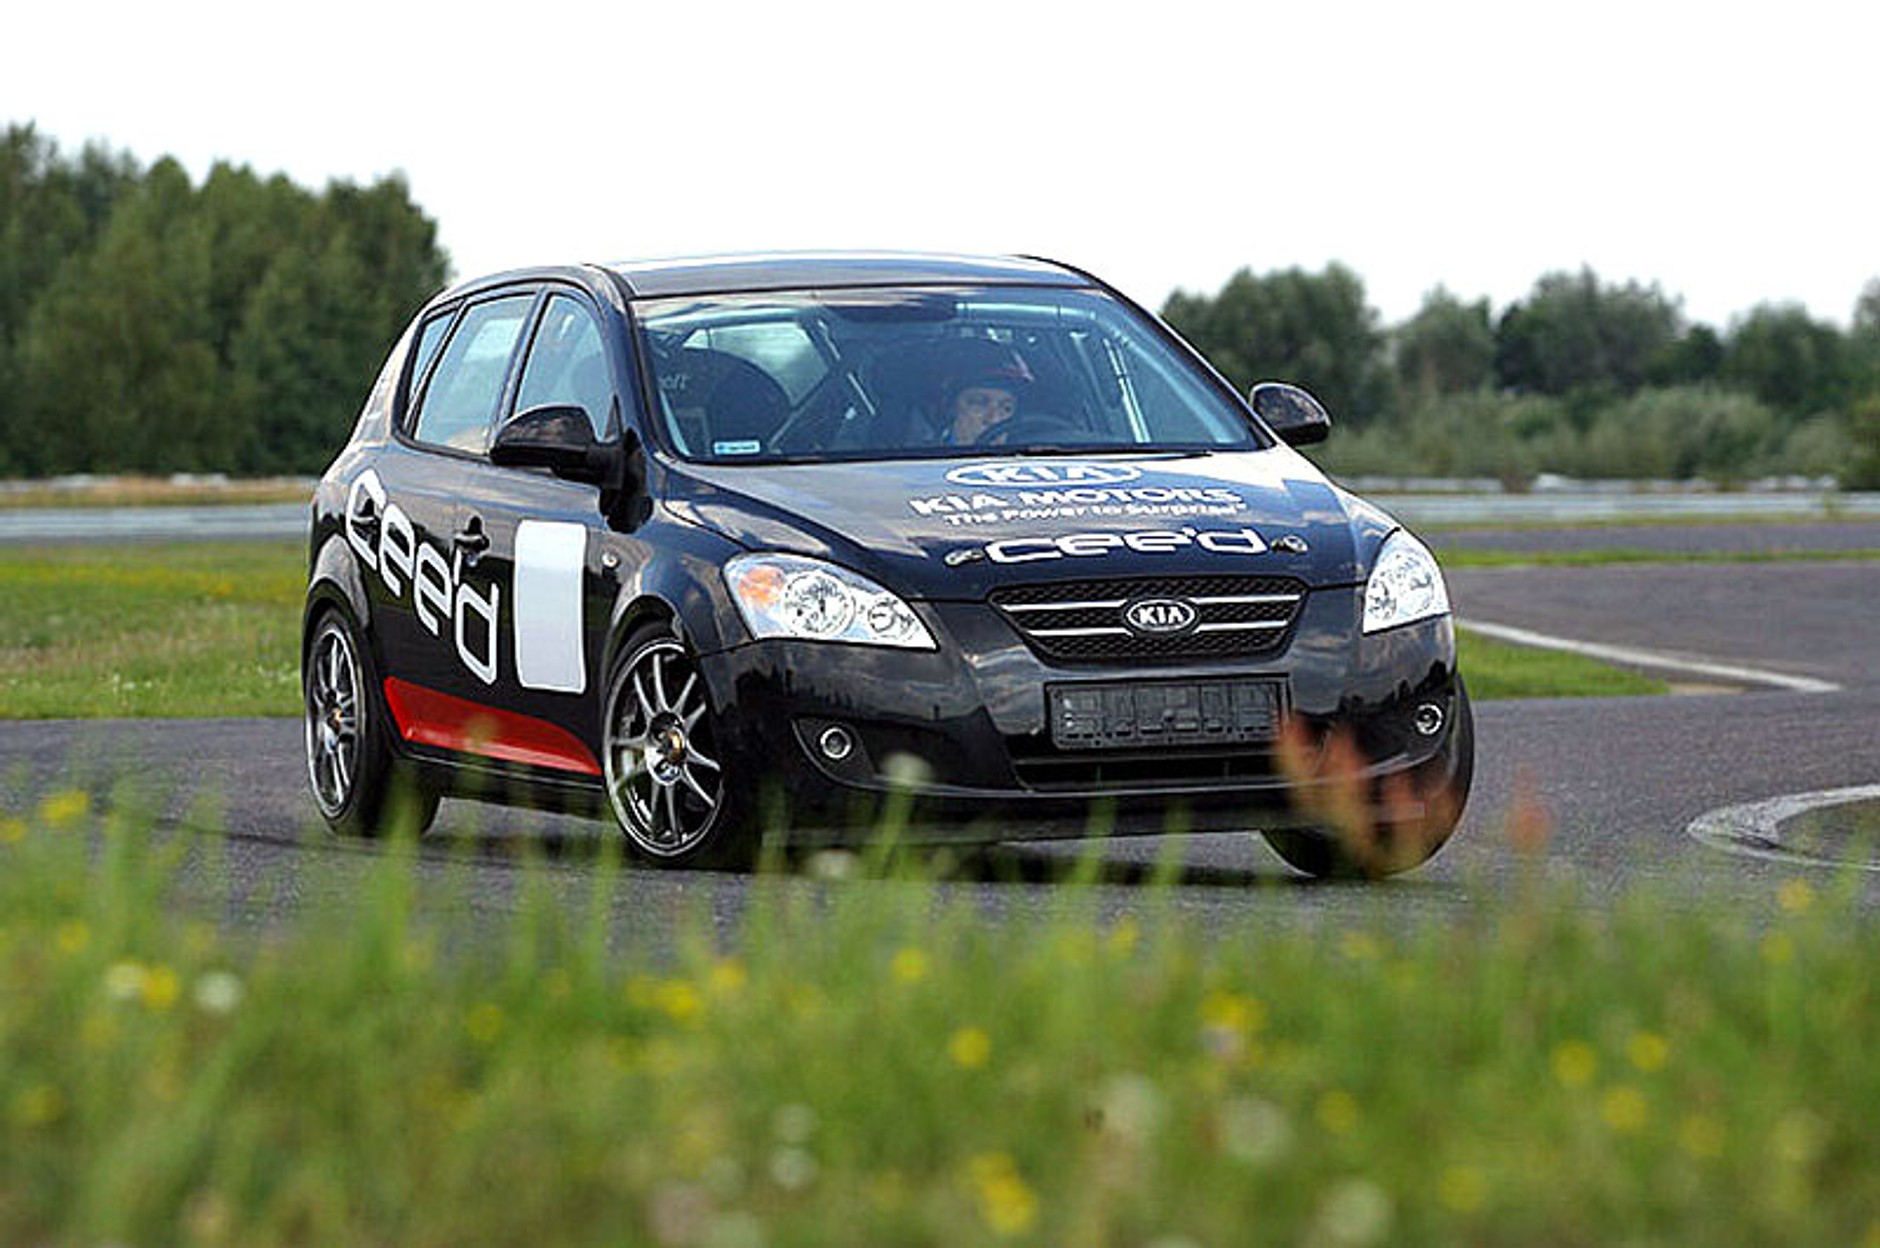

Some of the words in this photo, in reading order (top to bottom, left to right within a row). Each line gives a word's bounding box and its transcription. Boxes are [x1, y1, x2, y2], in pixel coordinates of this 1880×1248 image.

[909, 494, 1010, 516] KIA
[1018, 488, 1242, 505] MOTORS
[944, 512, 998, 526] The
[1001, 507, 1087, 520] Power
[1138, 606, 1184, 625] KIA
